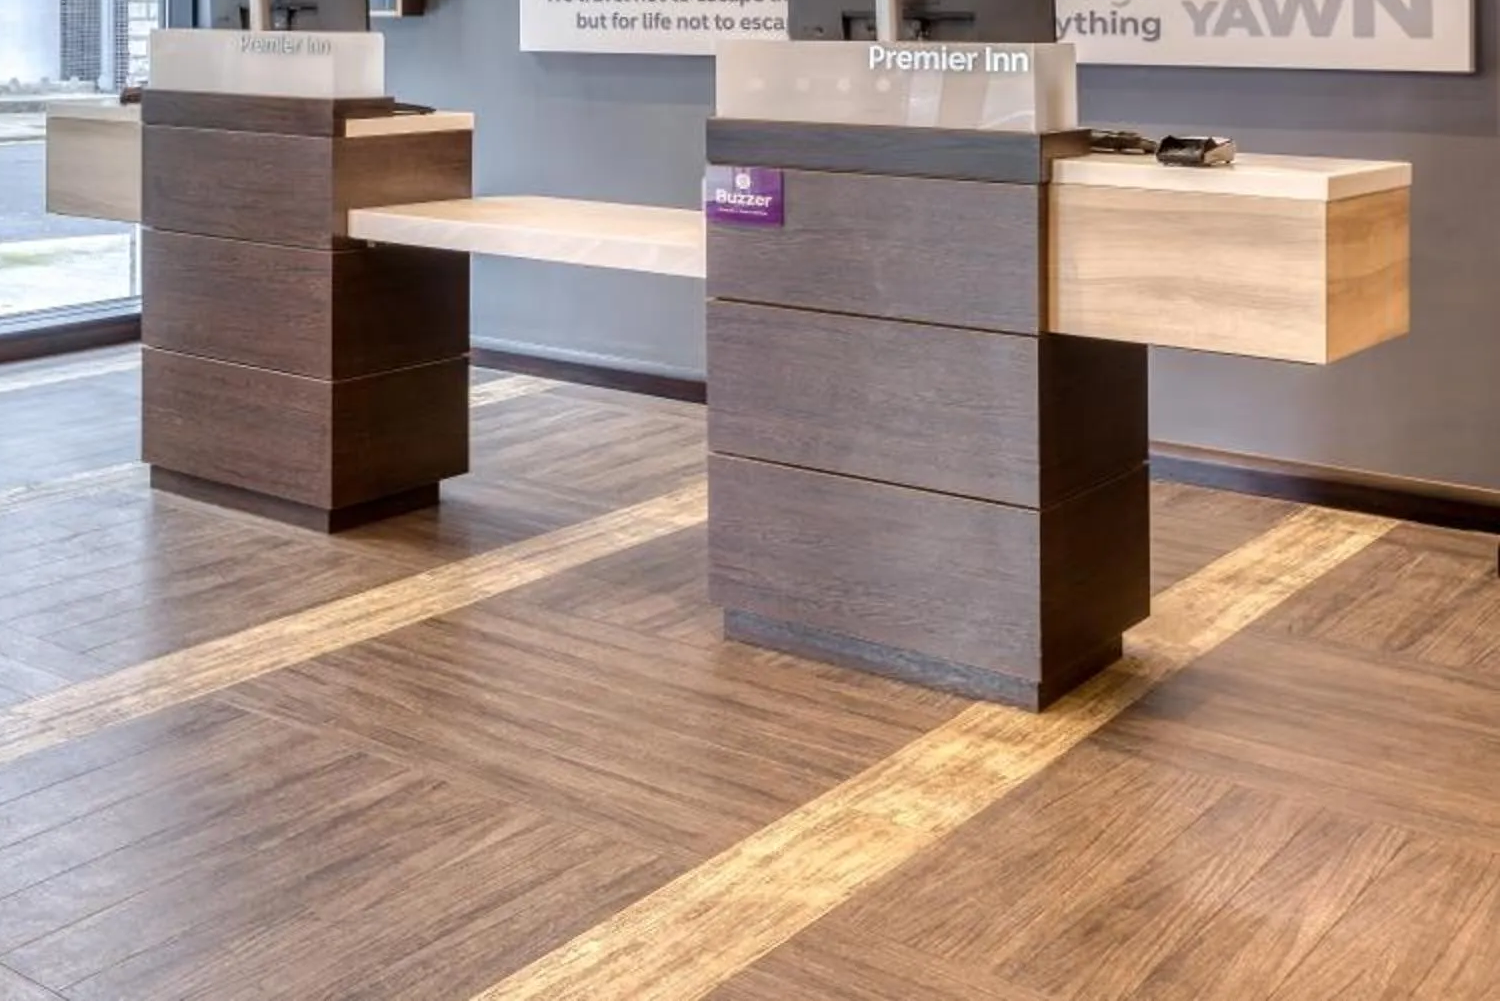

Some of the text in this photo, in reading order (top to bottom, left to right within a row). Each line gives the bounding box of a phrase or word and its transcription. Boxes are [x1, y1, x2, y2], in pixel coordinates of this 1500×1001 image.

[576, 12, 785, 30] but for life not to esca
[1055, 11, 1161, 40] ything
[869, 45, 1030, 73] Premier Inn
[715, 187, 773, 208] Buzzer
